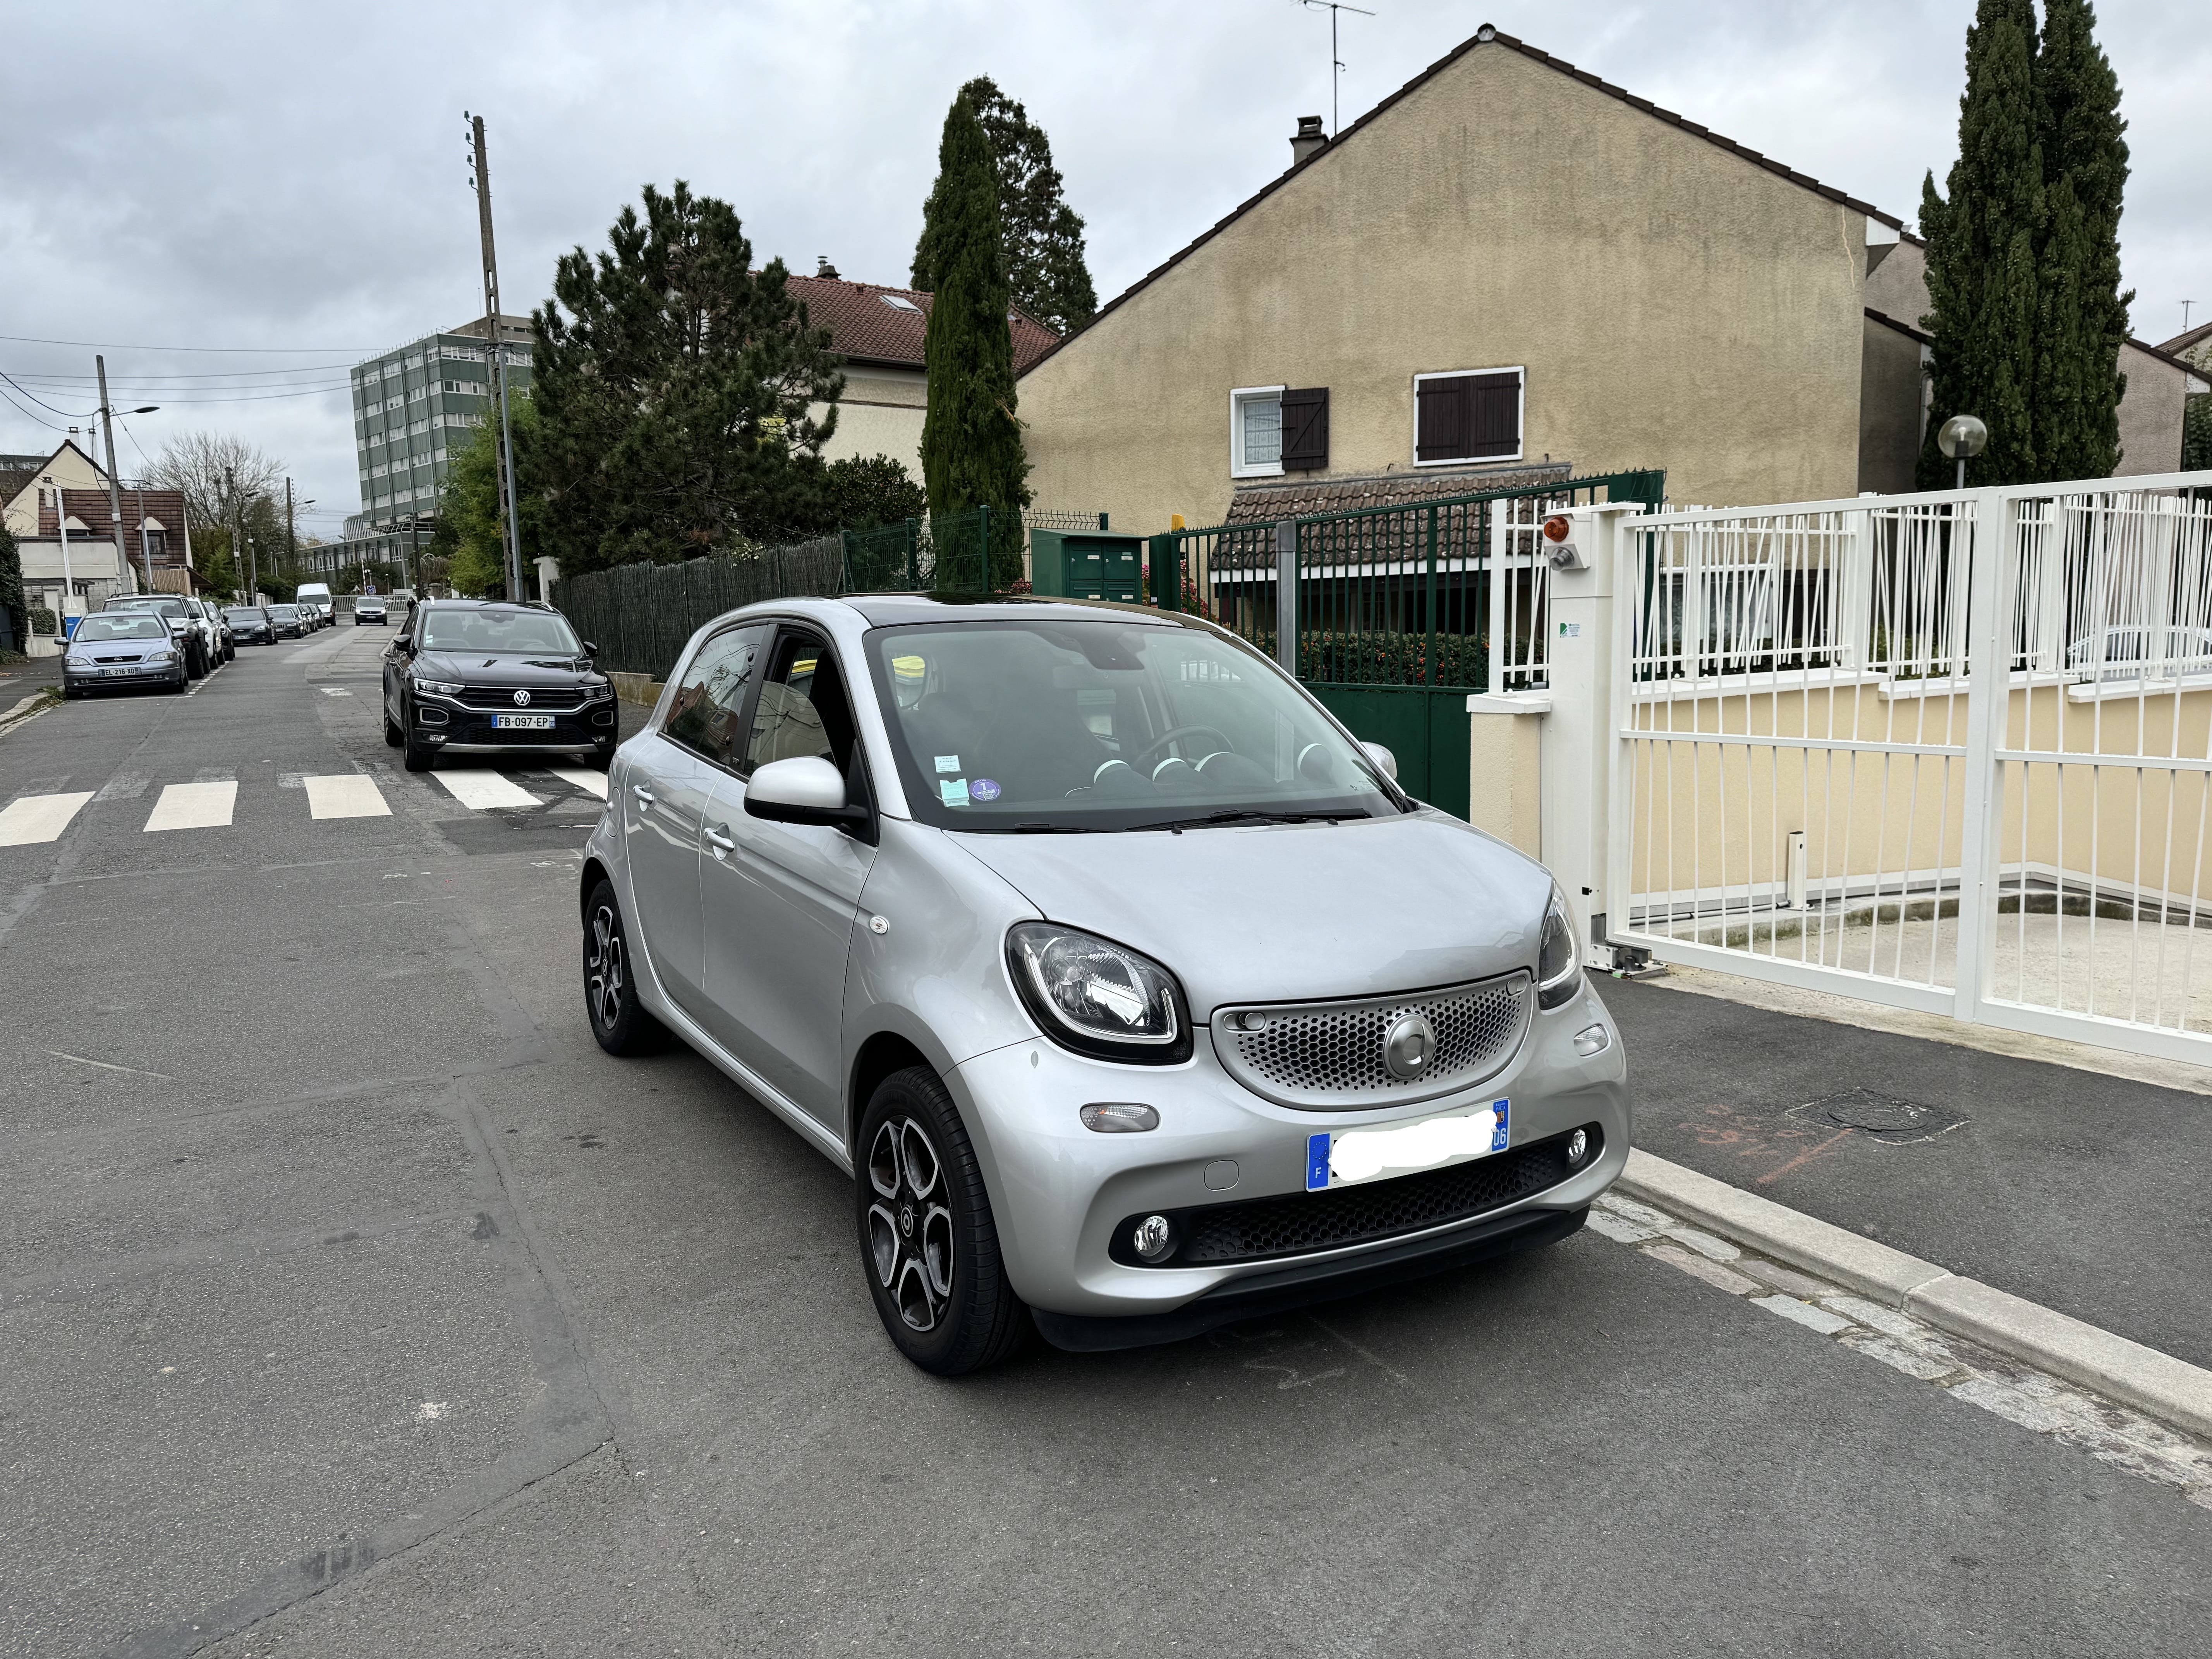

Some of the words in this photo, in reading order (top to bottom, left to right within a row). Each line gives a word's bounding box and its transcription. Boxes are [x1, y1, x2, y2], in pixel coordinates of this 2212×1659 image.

[499, 717, 548, 727] FB-097-EP
[1493, 1127, 1506, 1146] 06
[1315, 1166, 1322, 1179] F
